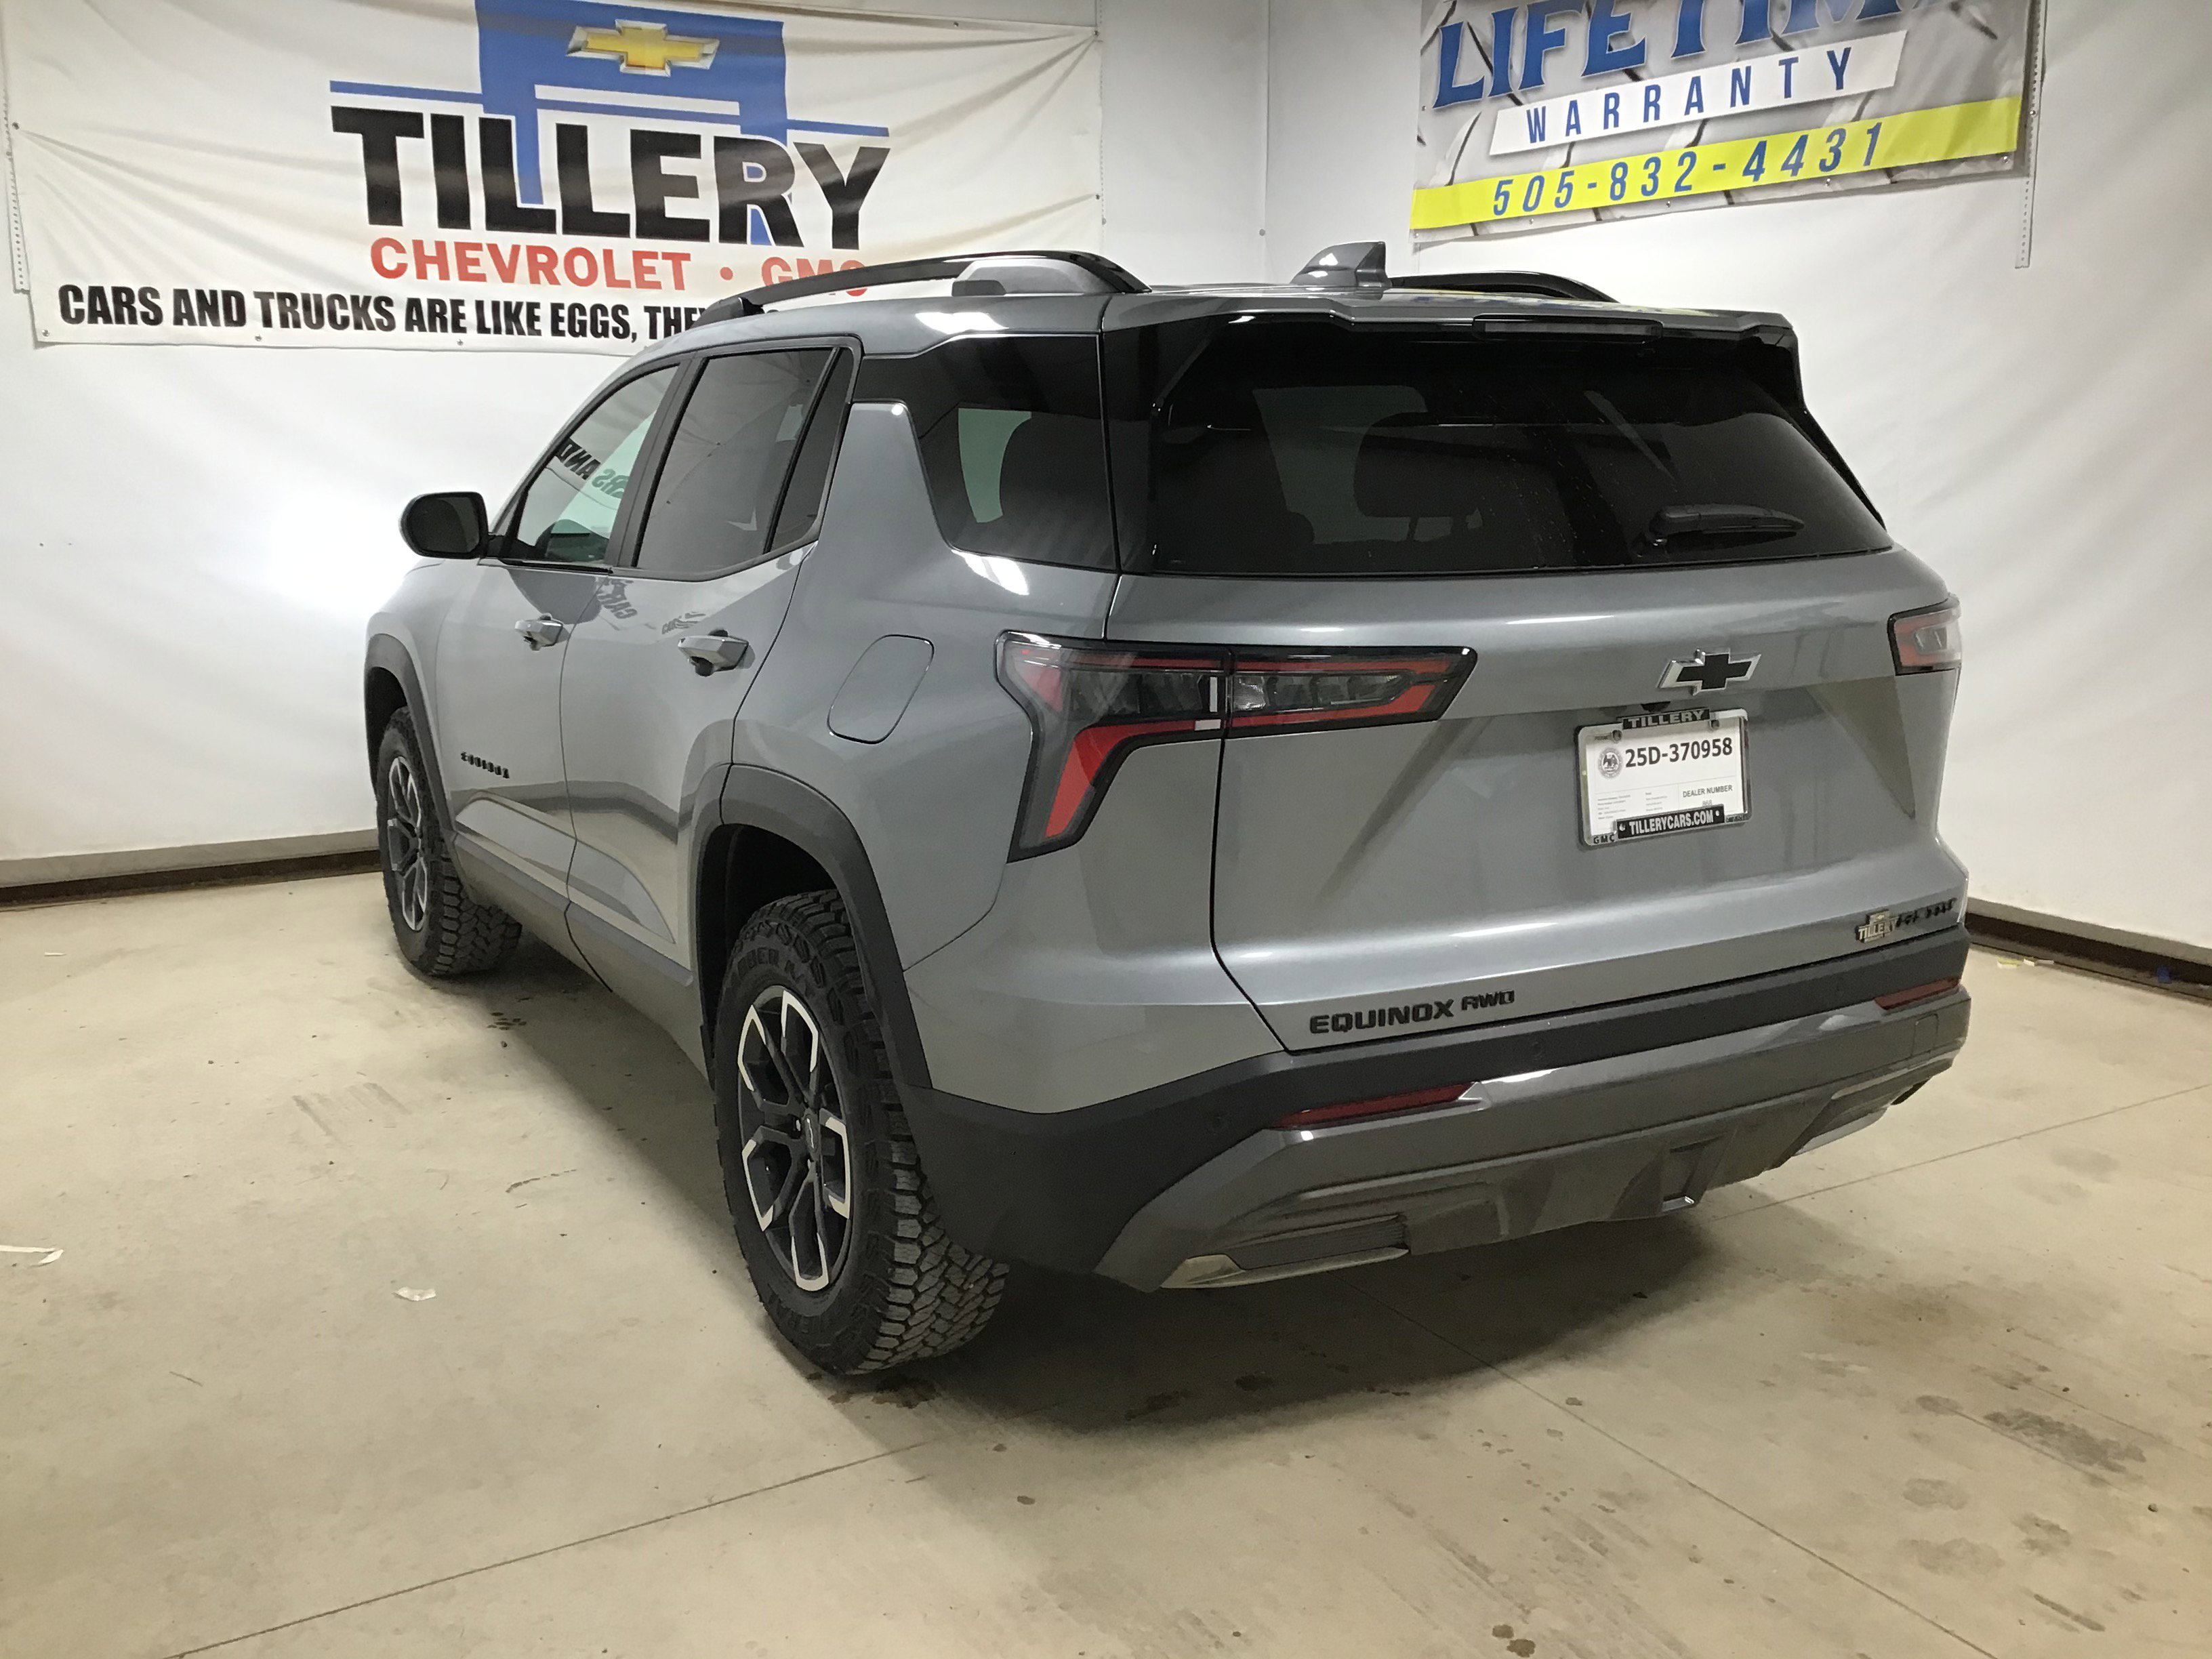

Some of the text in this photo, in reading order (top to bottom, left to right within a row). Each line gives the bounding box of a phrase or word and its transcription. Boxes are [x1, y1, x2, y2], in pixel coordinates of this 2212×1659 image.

[1527, 47, 1851, 144] WARRANTY
[331, 105, 890, 250] TILLERY
[1492, 121, 1883, 216] 505-832-4431
[370, 237, 691, 291] CHEVROLET
[58, 284, 163, 326] CARS
[172, 288, 247, 327] AND
[253, 291, 396, 332] TRUCKS
[407, 298, 468, 333] ARE
[474, 300, 542, 337] LIKE
[550, 302, 637, 343] EGGS,
[1628, 710, 1705, 729] TILLERY
[1624, 737, 1733, 768] 25D-370958
[1682, 785, 1734, 798] DEALER NUMBER
[1593, 834, 1615, 844] GMC
[1628, 809, 1714, 836] TILLERYCARS.COM
[1309, 989, 1515, 1034] EQUINOX AWD
